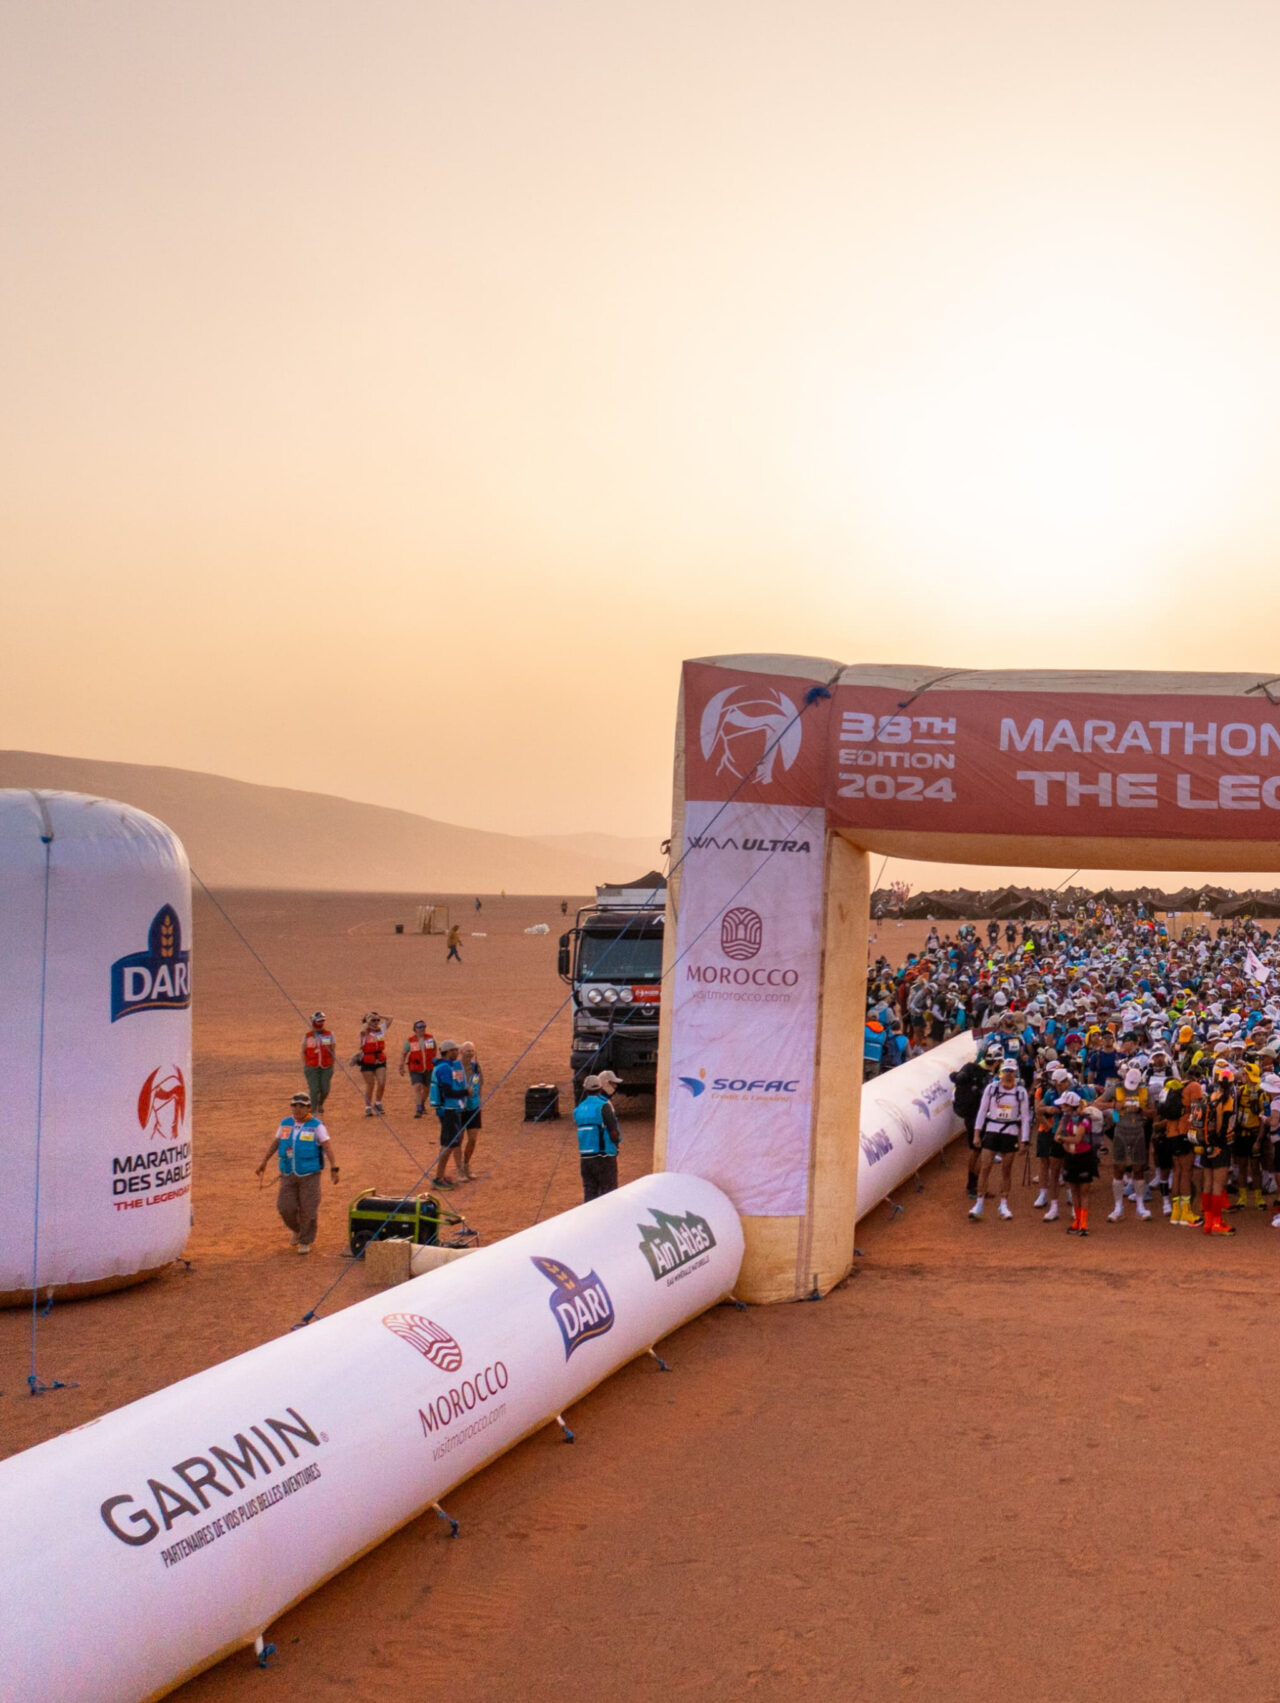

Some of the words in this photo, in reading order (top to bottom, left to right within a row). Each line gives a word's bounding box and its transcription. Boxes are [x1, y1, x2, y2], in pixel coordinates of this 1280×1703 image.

[839, 711, 956, 745] 38TH
[838, 749, 956, 770] EDITION
[838, 773, 957, 803] 2024
[1016, 770, 1160, 808] THE
[741, 839, 811, 853] ULTRA
[686, 965, 799, 987] MOROCCO
[711, 1078, 801, 1093] SOFAC
[113, 1143, 191, 1175] MARATHO
[113, 1174, 152, 1196] DES
[155, 1161, 191, 1188] SABLE
[113, 1198, 144, 1212] THE
[665, 1221, 711, 1262] Atlas
[556, 1282, 610, 1340] DARI
[418, 1360, 509, 1439] MOROCCO
[100, 1406, 321, 1547] GARMIN
[160, 1523, 216, 1568] PARTENAIRES
[211, 1517, 227, 1538] DE
[223, 1513, 241, 1532] VOS
[238, 1499, 259, 1523] PLUS
[255, 1484, 284, 1513] BELLES
[282, 1462, 322, 1497] AVENTURES
